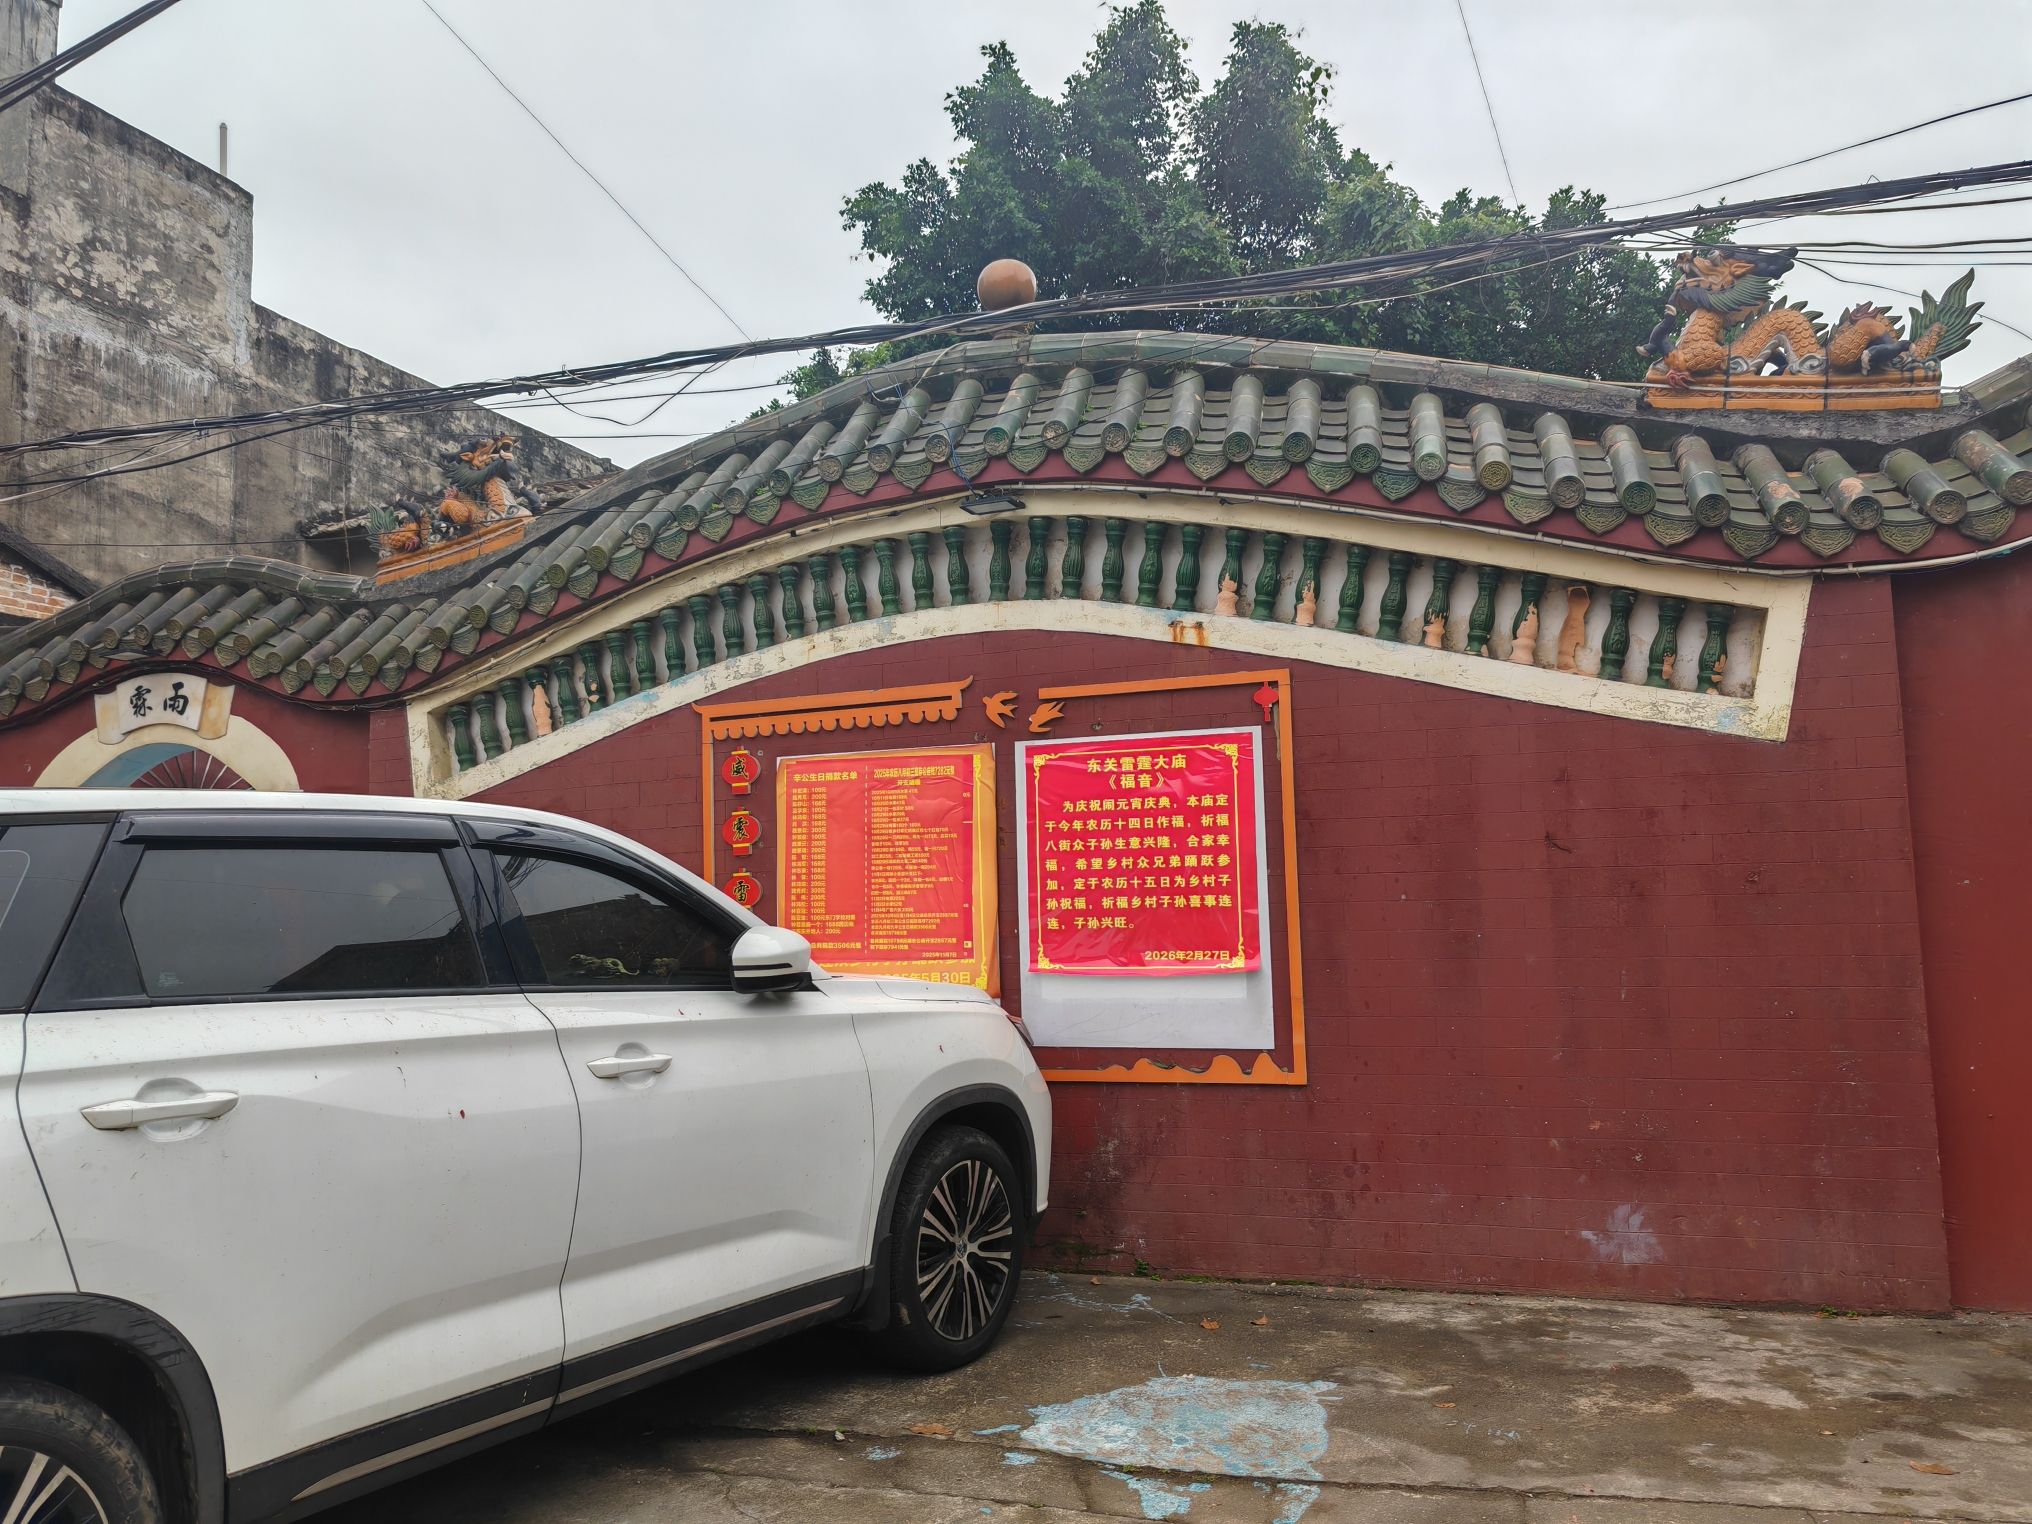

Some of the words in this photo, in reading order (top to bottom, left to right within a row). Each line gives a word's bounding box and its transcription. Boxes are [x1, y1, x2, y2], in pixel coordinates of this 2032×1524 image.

[1087, 754, 1187, 773] 东关雷霆大庙
[1108, 772, 1165, 790] 《福音》
[1063, 794, 1229, 812] 为庆祝闹元宵庆典，本庙定
[1045, 814, 1230, 832] 于今年农历十四日作福，祈福
[1045, 834, 1231, 851] 八街众子孙生意兴隆，合家幸
[1045, 854, 1231, 871] 福，希望乡村众兄弟踊跃参
[1046, 874, 1232, 890] 加，定于农历十五日为乡村子
[1046, 894, 1233, 910] 孙祝福，祈福乡村子孙喜事连
[1047, 917, 1135, 930] 连，子孙兴旺。
[1144, 950, 1230, 961] 2026年2月27日
